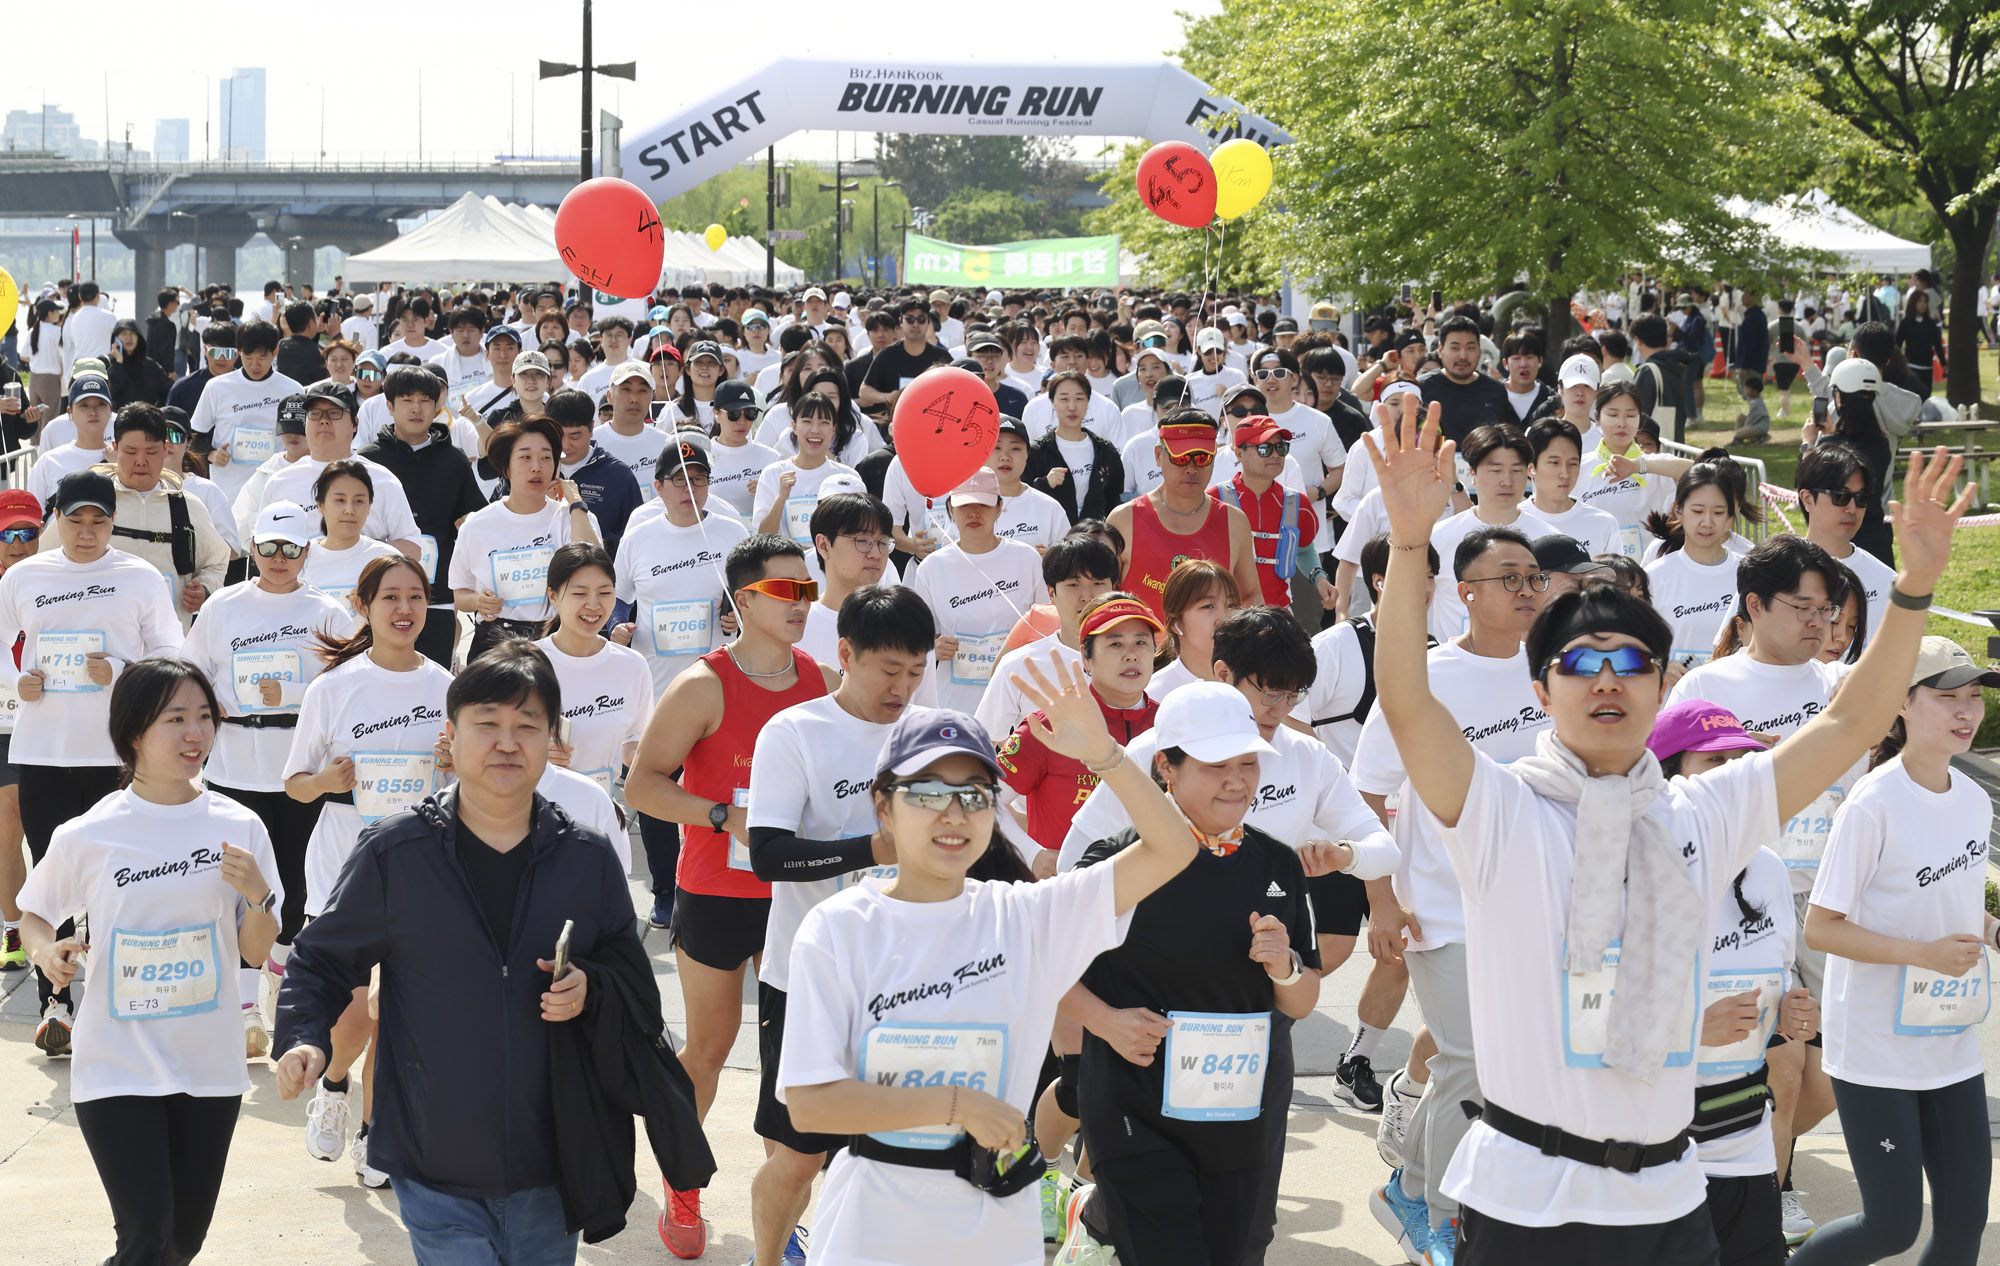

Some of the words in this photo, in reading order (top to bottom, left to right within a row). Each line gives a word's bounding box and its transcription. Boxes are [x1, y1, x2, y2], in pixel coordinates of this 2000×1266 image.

[837, 82, 1011, 116] BURNING
[1017, 86, 1104, 116] RUN
[968, 117, 1003, 125] Casual
[1006, 118, 1049, 127] Running
[639, 90, 766, 181] START
[232, 401, 262, 413] Burning
[263, 398, 281, 406] Run
[922, 391, 993, 447] 45
[244, 440, 271, 450] 7096
[708, 472, 742, 486] Burning
[743, 468, 762, 477] Run
[1581, 485, 1618, 503] Burning
[1619, 480, 1641, 490] Run
[1016, 522, 1039, 532] Run
[651, 558, 696, 577] Burning
[697, 551, 722, 563] Run
[500, 573, 509, 581] W
[35, 592, 84, 608] Burning
[86, 585, 116, 598] Run
[949, 588, 994, 609] Burning
[995, 580, 1020, 593] Run
[1673, 601, 1721, 618] Burning
[658, 624, 667, 632] M
[670, 619, 706, 632] 7066
[231, 632, 278, 651] Burning
[280, 625, 309, 638] Run
[41, 656, 51, 664] M
[52, 679, 66, 687] F-1
[238, 676, 248, 684] W
[595, 695, 624, 709] Run
[352, 714, 411, 739] Burning
[411, 706, 442, 722] Run
[1462, 717, 1520, 742] Burning
[1742, 711, 1803, 733] Burning
[361, 781, 373, 790] W
[376, 779, 425, 793] 8559
[833, 778, 874, 799] Burn
[1260, 784, 1296, 805] Run
[783, 859, 806, 869] SAFETY
[807, 855, 843, 867] EIDER
[1915, 853, 1968, 887] Burning
[1966, 839, 1987, 857] Run
[113, 860, 190, 887] Burning
[851, 871, 867, 883] M
[1739, 917, 1774, 939] Run
[121, 938, 161, 948] BURNING
[162, 937, 179, 946] RUN
[192, 934, 207, 942] 7km
[122, 966, 138, 978] W
[141, 960, 205, 982] 8290
[953, 953, 1006, 985] Run
[156, 985, 178, 994] 허유정
[1734, 979, 1754, 988] RUN
[1913, 981, 1928, 993] W
[1930, 978, 1981, 997] 8217
[129, 999, 159, 1011] E-73
[1582, 993, 1602, 1009] M
[1179, 1022, 1223, 1033] BURNING
[1225, 1024, 1244, 1032] RUN
[1254, 1024, 1266, 1032] 7km
[876, 1033, 930, 1045] BURNING
[932, 1034, 959, 1045] RUN
[976, 1037, 997, 1046] 7km
[1181, 1056, 1199, 1070] W
[1201, 1053, 1260, 1074] 8476
[877, 1072, 899, 1087] W
[901, 1070, 987, 1092] 8456
[1213, 1081, 1235, 1091] 황미라
